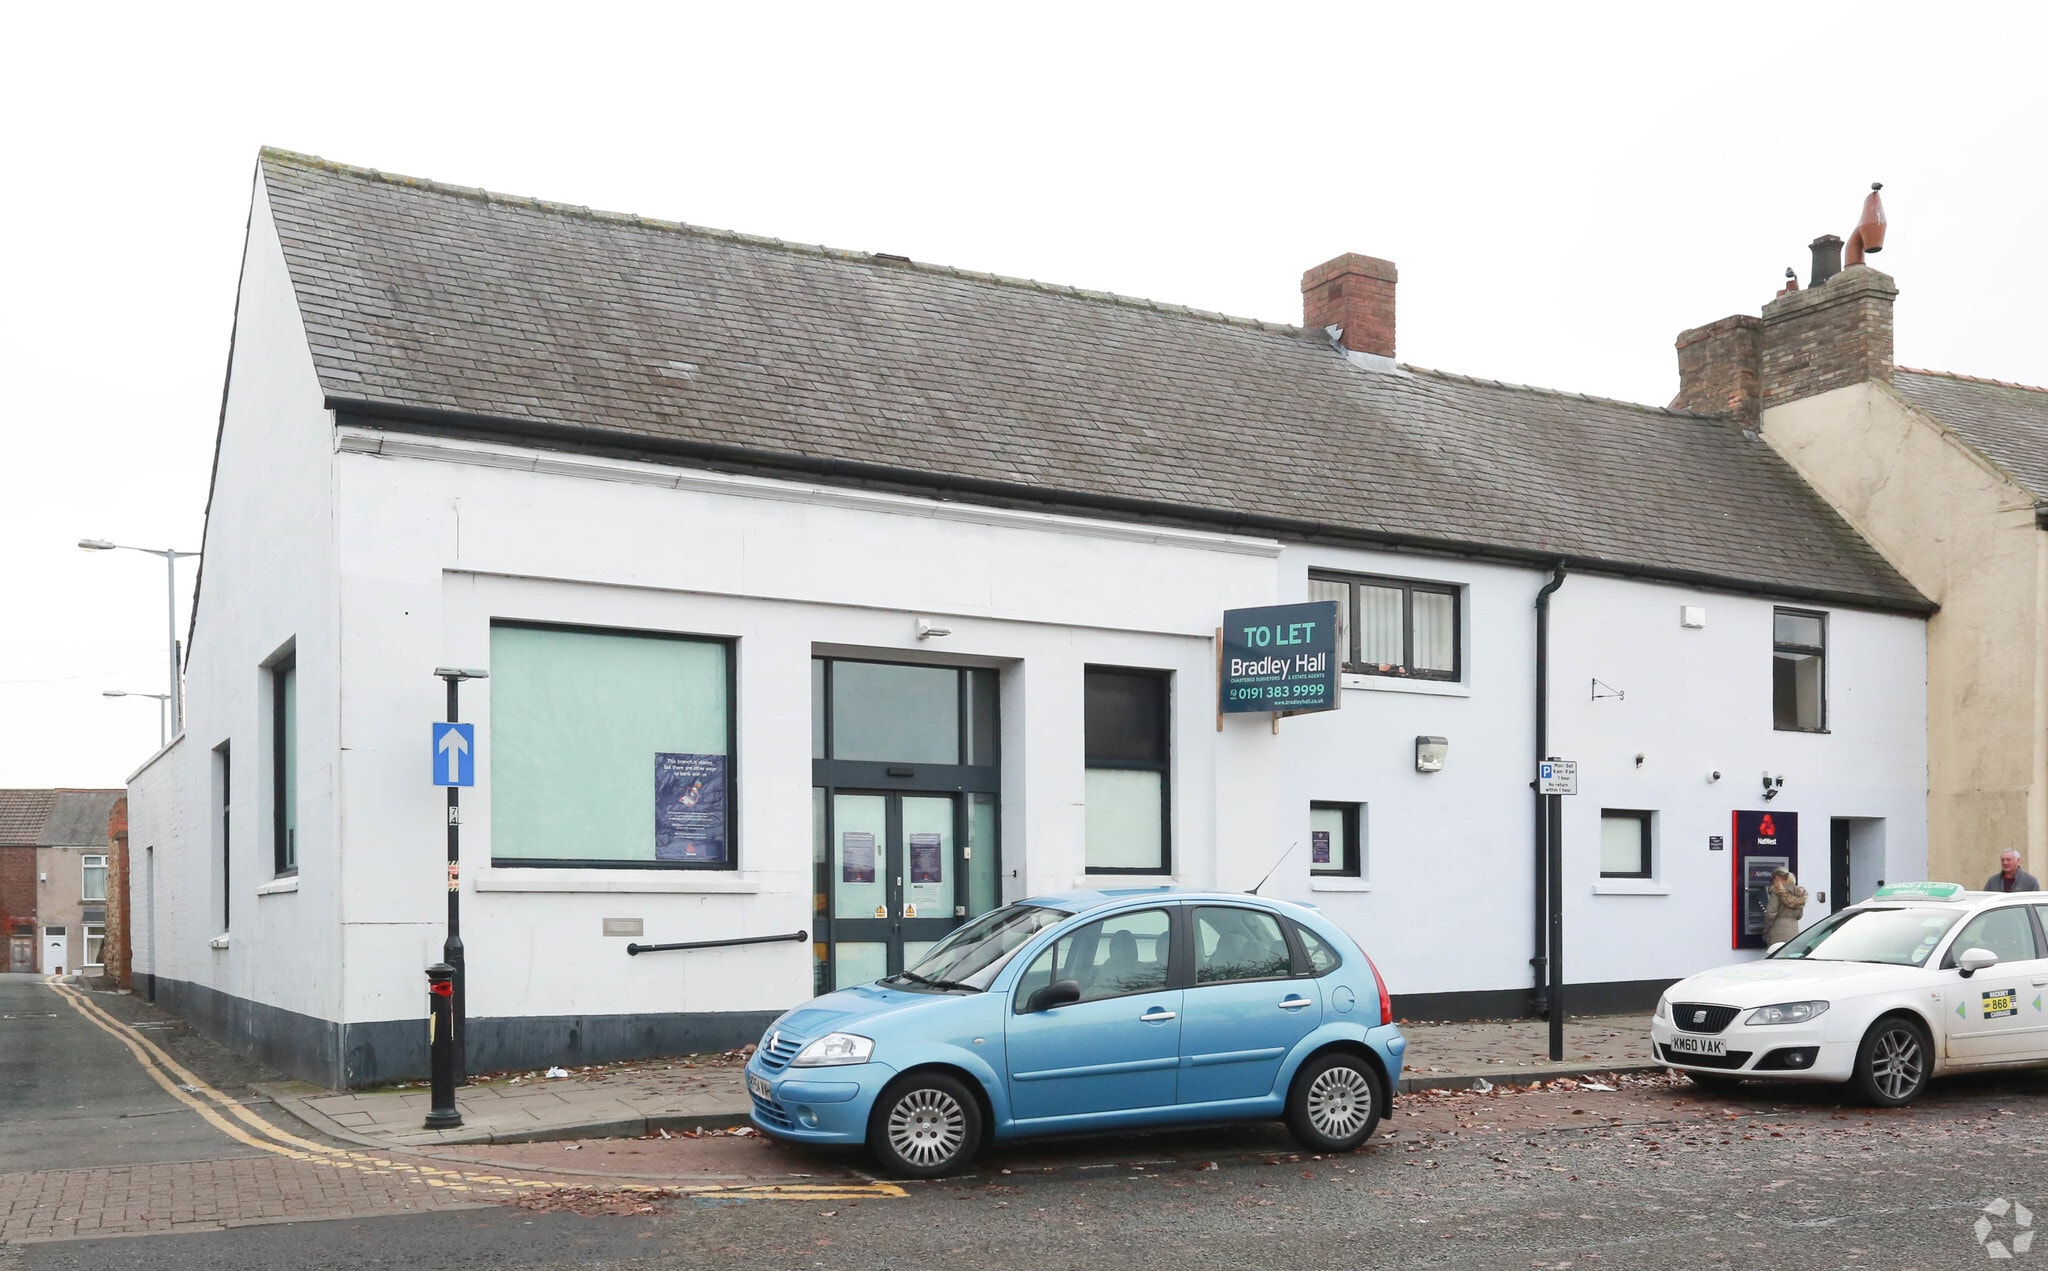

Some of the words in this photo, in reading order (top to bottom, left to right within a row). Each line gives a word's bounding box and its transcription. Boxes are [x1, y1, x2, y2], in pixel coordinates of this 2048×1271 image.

[1244, 626, 1271, 648] TO
[1276, 622, 1316, 645] LET
[1231, 656, 1291, 681] Bradley
[1295, 652, 1326, 673] Hall
[1238, 687, 1263, 700] 0191
[1266, 686, 1290, 698] 383
[1293, 683, 1325, 697] 9999
[1274, 698, 1324, 706] www.bradleyhall.co.uk
[1543, 766, 1551, 777] P
[1757, 837, 1777, 845] NatWest
[1992, 998, 2008, 1010] 868
[1674, 1037, 1698, 1052] KM60
[1701, 1041, 1722, 1054] VAK
